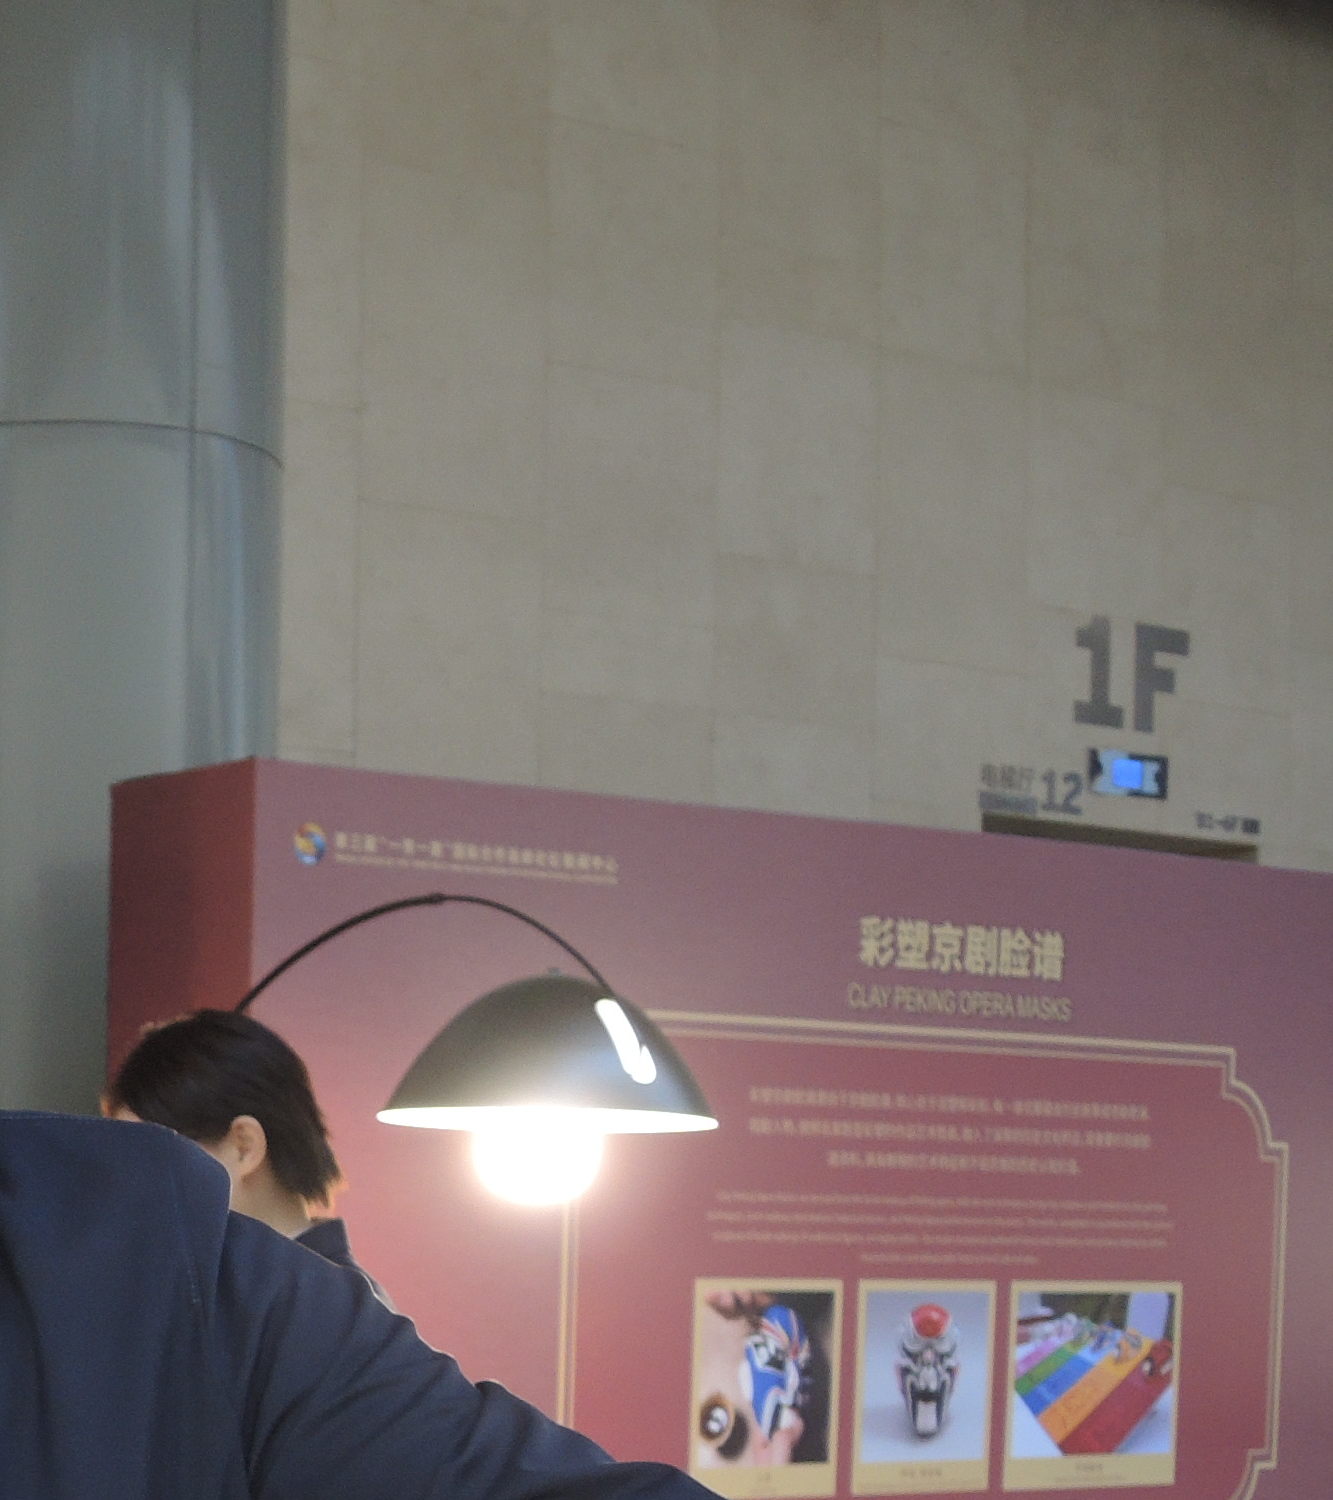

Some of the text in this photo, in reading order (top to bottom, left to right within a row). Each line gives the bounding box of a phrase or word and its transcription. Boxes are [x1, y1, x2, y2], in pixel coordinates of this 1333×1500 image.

[1073, 615, 1190, 733] 1F
[1041, 768, 1083, 815] 12
[859, 915, 1066, 982] 彩塑京剧脸谱
[959, 989, 1016, 1019] OPERA
